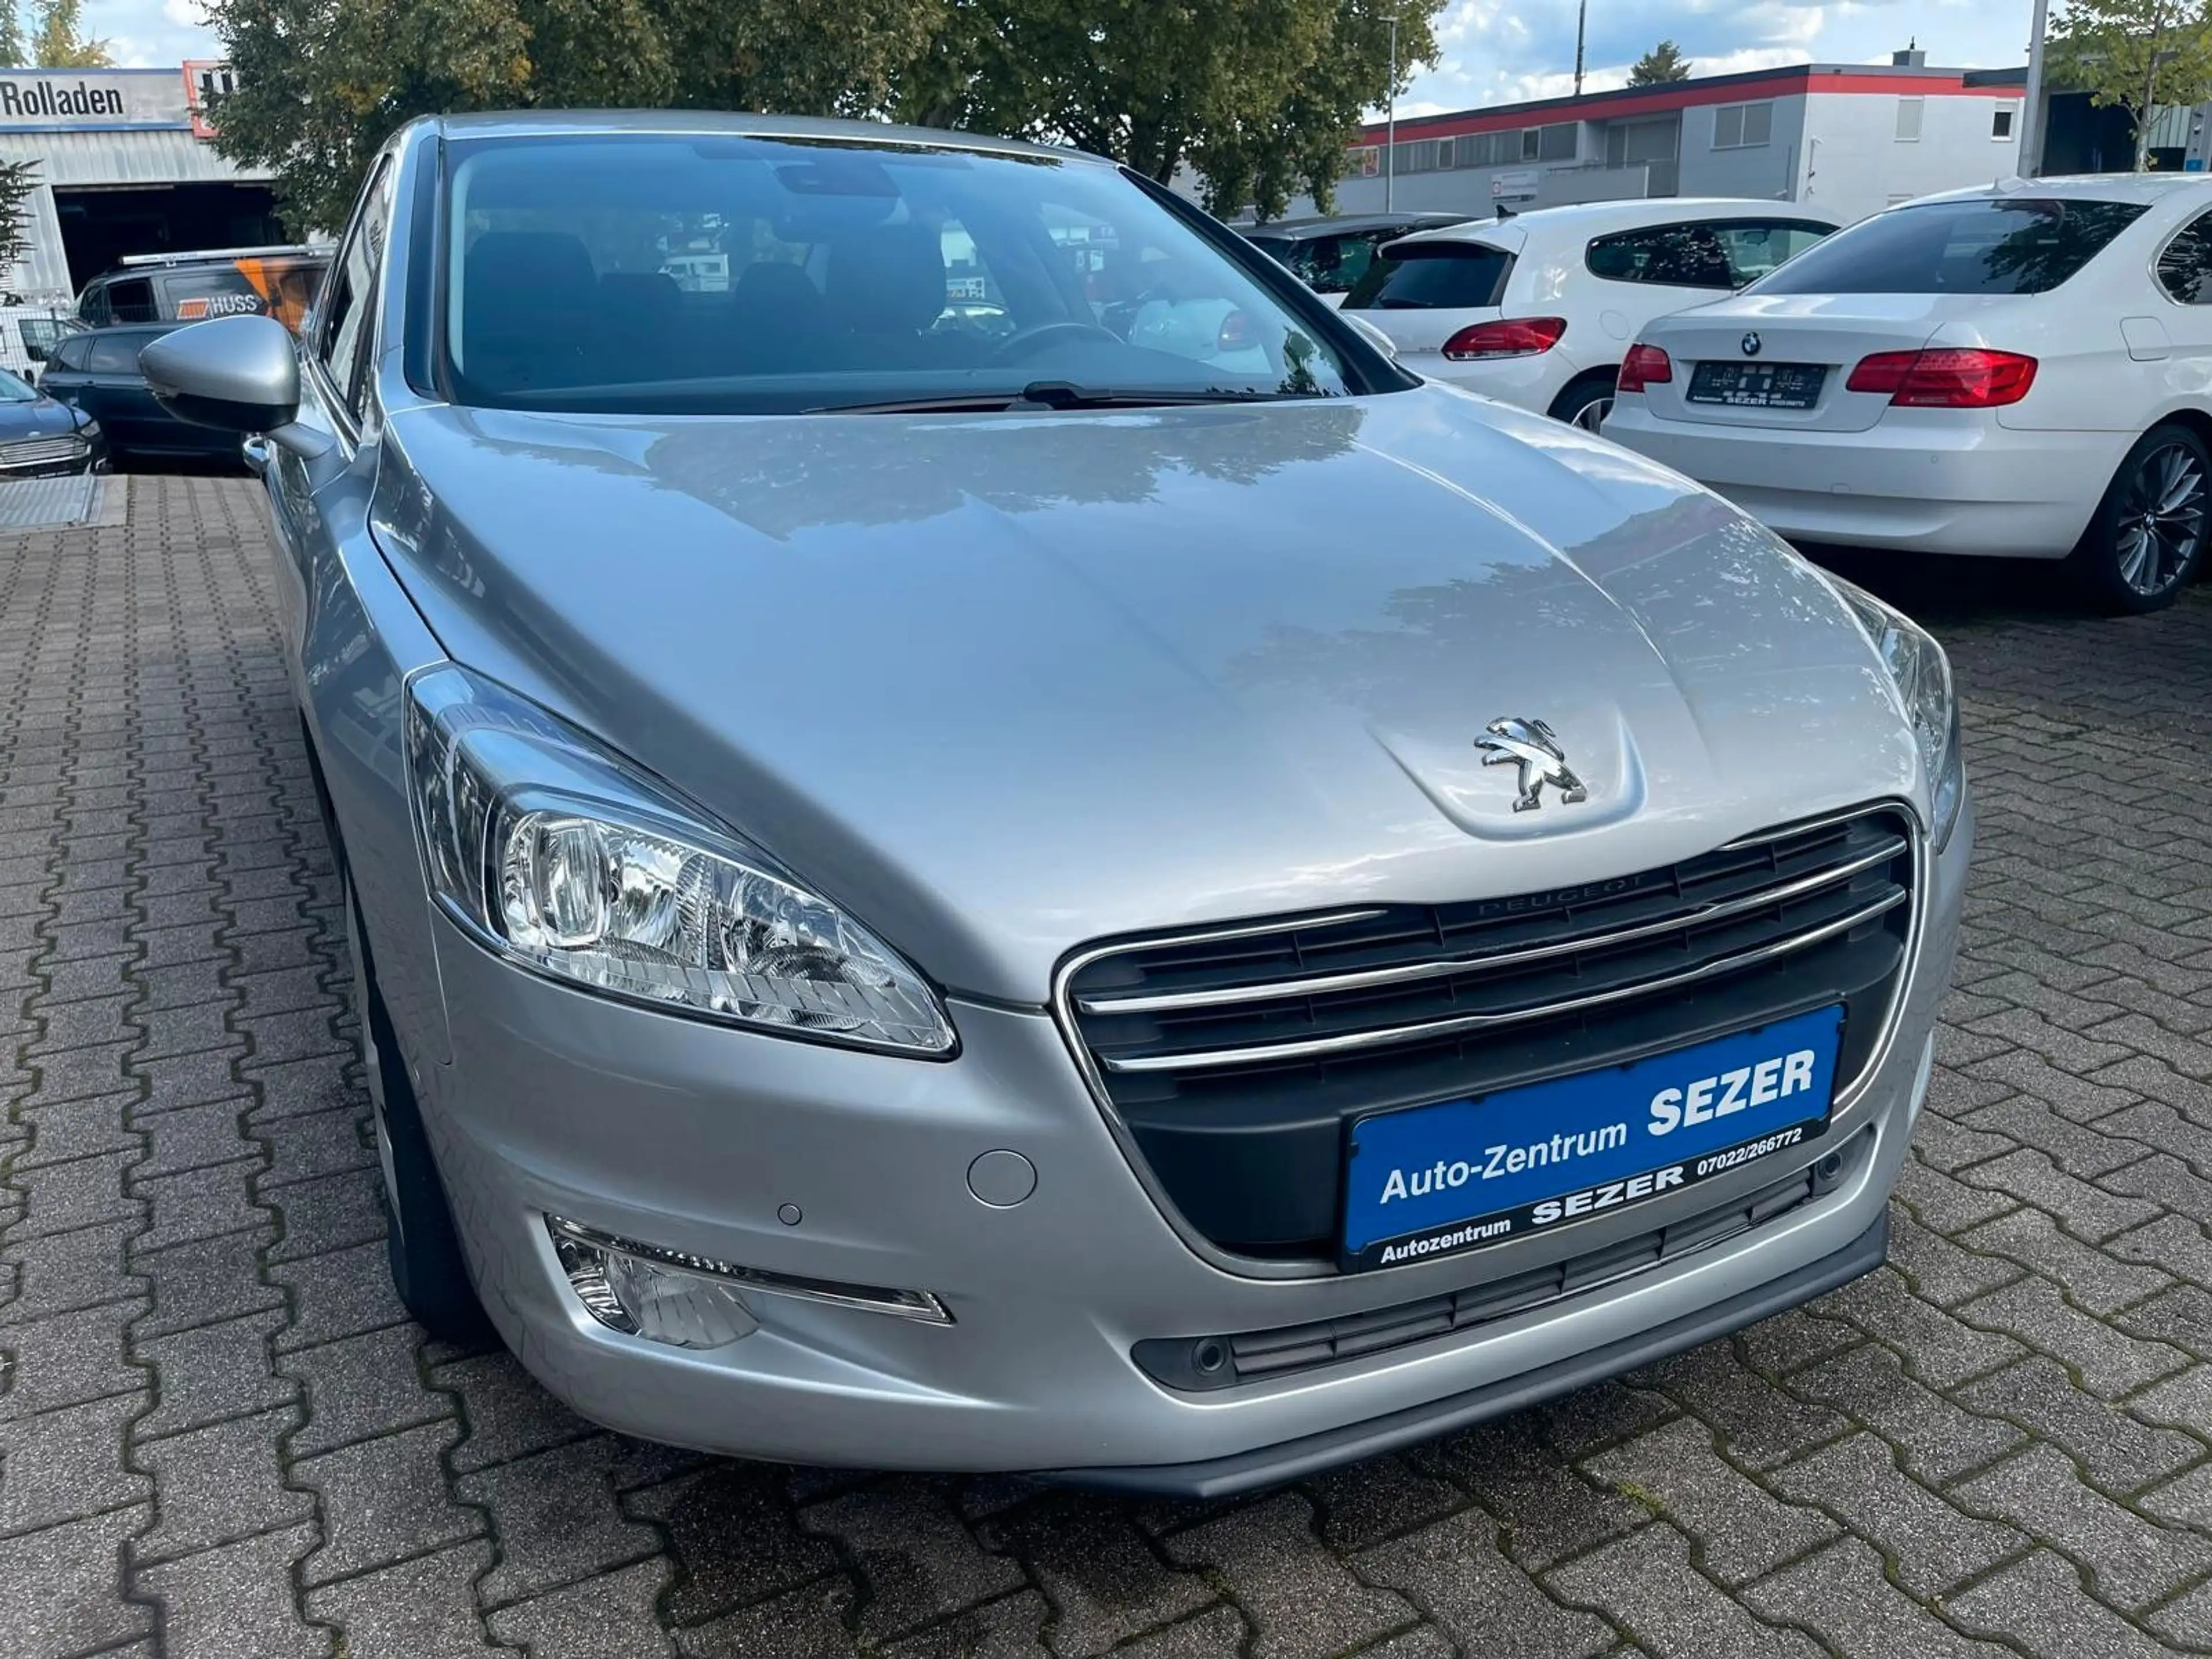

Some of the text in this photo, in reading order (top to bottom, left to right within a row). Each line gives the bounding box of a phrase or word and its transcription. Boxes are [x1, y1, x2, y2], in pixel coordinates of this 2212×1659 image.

[1, 81, 123, 116] Rolladen
[212, 294, 257, 313] HUSS
[1479, 875, 1643, 916] PEUGEOT
[1380, 1050, 1815, 1204] Auto-Zentrum SEZER
[1380, 1127, 1802, 1263] Autozentrum SEZER 07022/266772
